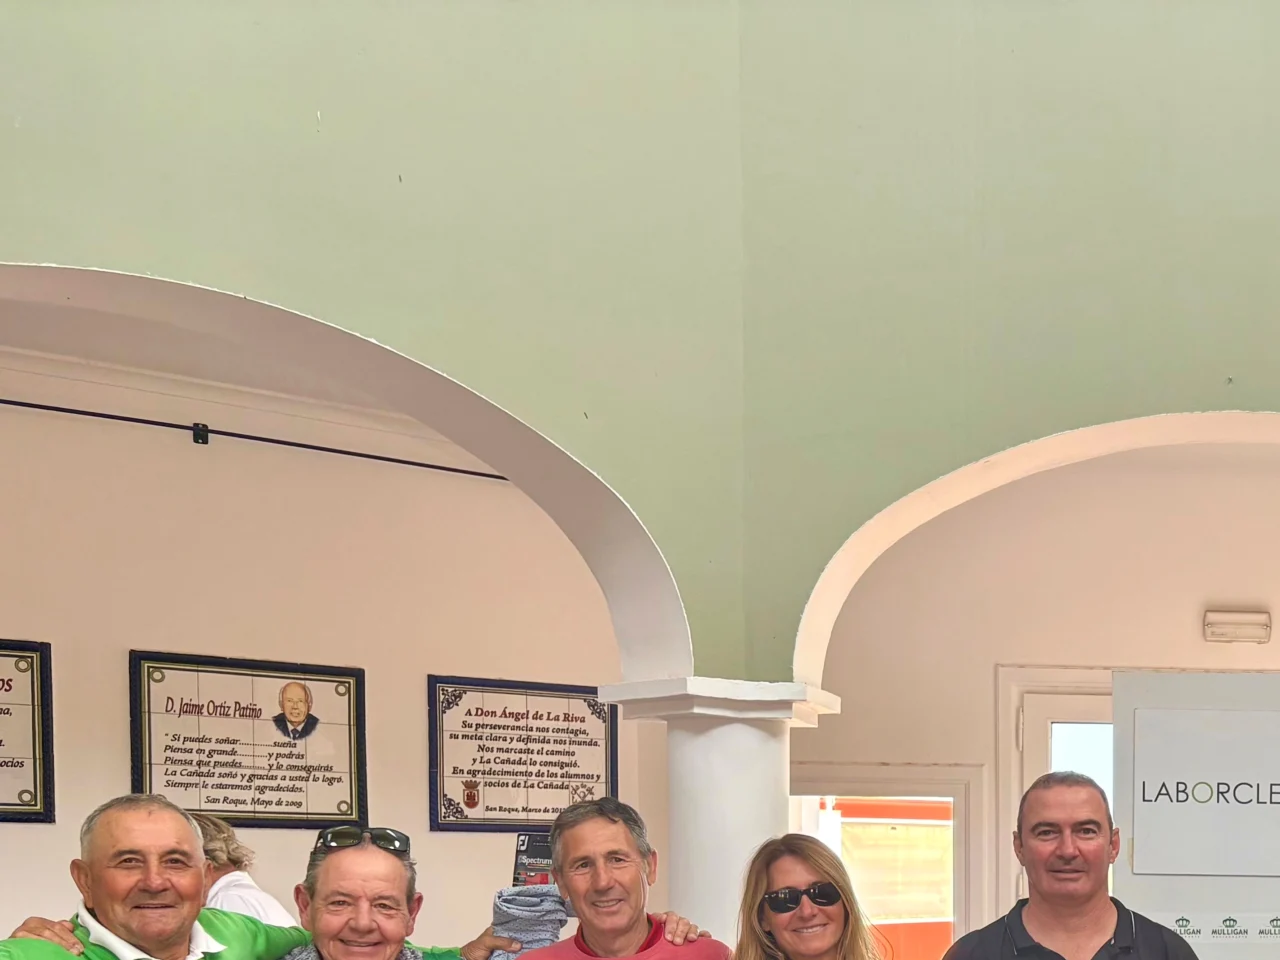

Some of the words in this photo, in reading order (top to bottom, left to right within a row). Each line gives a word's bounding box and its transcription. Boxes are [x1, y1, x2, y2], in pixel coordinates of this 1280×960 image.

[165, 696, 176, 713] D.
[178, 697, 204, 718] Jaime
[207, 700, 231, 717] Ortiz
[233, 701, 262, 718] Patiño
[465, 708, 472, 716] A
[474, 707, 497, 717] Don
[499, 706, 529, 722] Ángel
[532, 710, 544, 720] de
[546, 712, 560, 721] La
[562, 712, 586, 723] Riva
[461, 720, 473, 728] Su
[475, 723, 534, 732] perseverancia
[551, 727, 589, 736] contagia,
[182, 735, 212, 745] puedes
[461, 733, 483, 741] meta
[485, 733, 508, 741] clara
[516, 735, 551, 745] definida
[569, 738, 600, 747] inunda.
[164, 745, 193, 754] Piensa
[275, 751, 305, 761] podrás
[477, 744, 494, 753] Nos
[536, 747, 543, 755] el
[164, 756, 193, 764] Piensa
[196, 760, 211, 769] que
[268, 763, 274, 772] y
[276, 762, 283, 770] lo
[286, 763, 333, 774] conseguirás
[471, 757, 477, 766] y
[479, 756, 491, 764] La
[494, 756, 527, 765] Cañada
[529, 758, 537, 766] lo
[539, 760, 580, 770] consiguió.
[164, 768, 177, 776] La
[180, 769, 215, 778] Cañada
[217, 771, 237, 779] soñó
[240, 774, 246, 782] y
[247, 773, 278, 783] gracias
[289, 774, 310, 782] usted
[312, 774, 319, 782] lo
[452, 766, 464, 775] En
[467, 768, 533, 778] agradecimiento
[535, 769, 545, 778] de
[547, 770, 558, 778] los
[560, 771, 594, 780] alumnos
[596, 774, 601, 782] y
[164, 780, 200, 791] Siempre
[202, 781, 208, 789] le
[211, 782, 252, 791] estaremos
[254, 784, 305, 794] agradecidos.
[511, 780, 521, 788] de
[537, 781, 569, 790] Cañada
[204, 796, 220, 804] San
[222, 796, 248, 807] Roque,
[250, 798, 273, 808] Mayo
[275, 798, 283, 806] de
[518, 835, 529, 850] FJ
[522, 855, 553, 865] Spectrum
